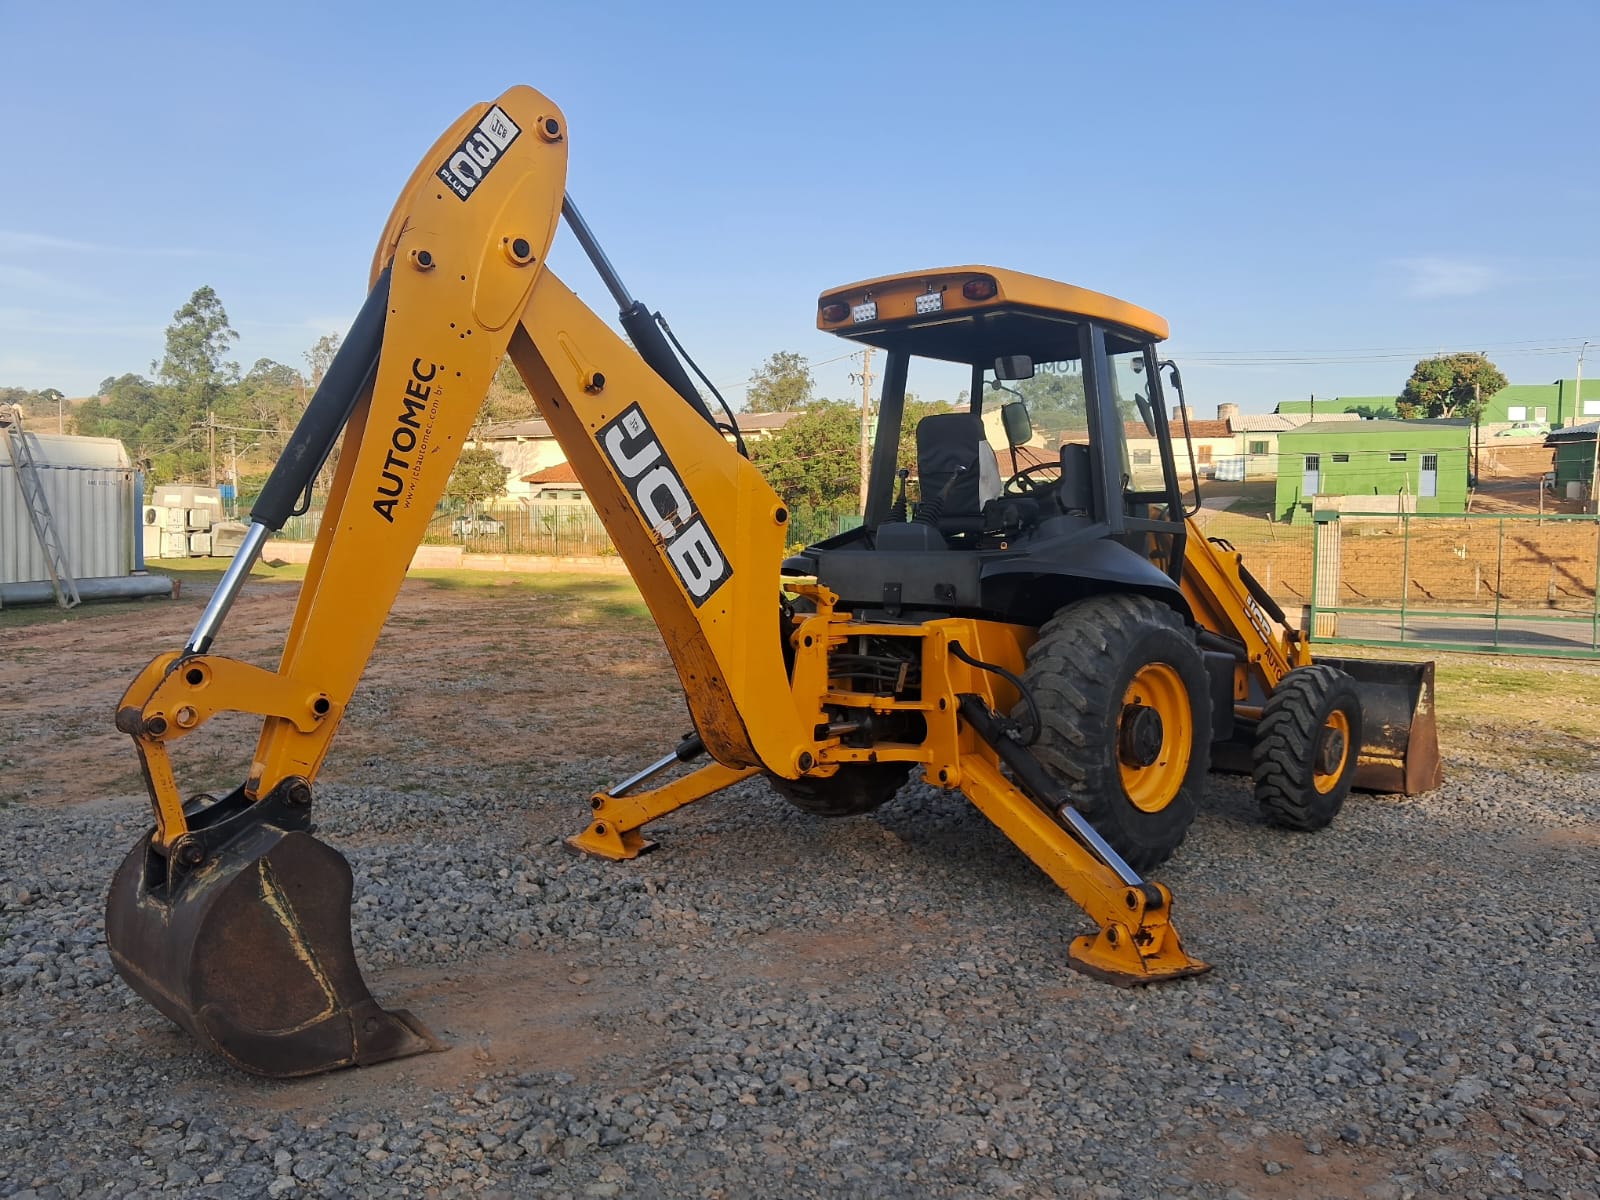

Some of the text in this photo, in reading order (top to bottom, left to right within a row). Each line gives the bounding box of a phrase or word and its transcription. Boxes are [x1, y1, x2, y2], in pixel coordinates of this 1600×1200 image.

[491, 119, 508, 138] JCB
[441, 170, 468, 196] PLUS
[373, 357, 436, 523] AUTOMEC
[605, 424, 724, 597] JCB
